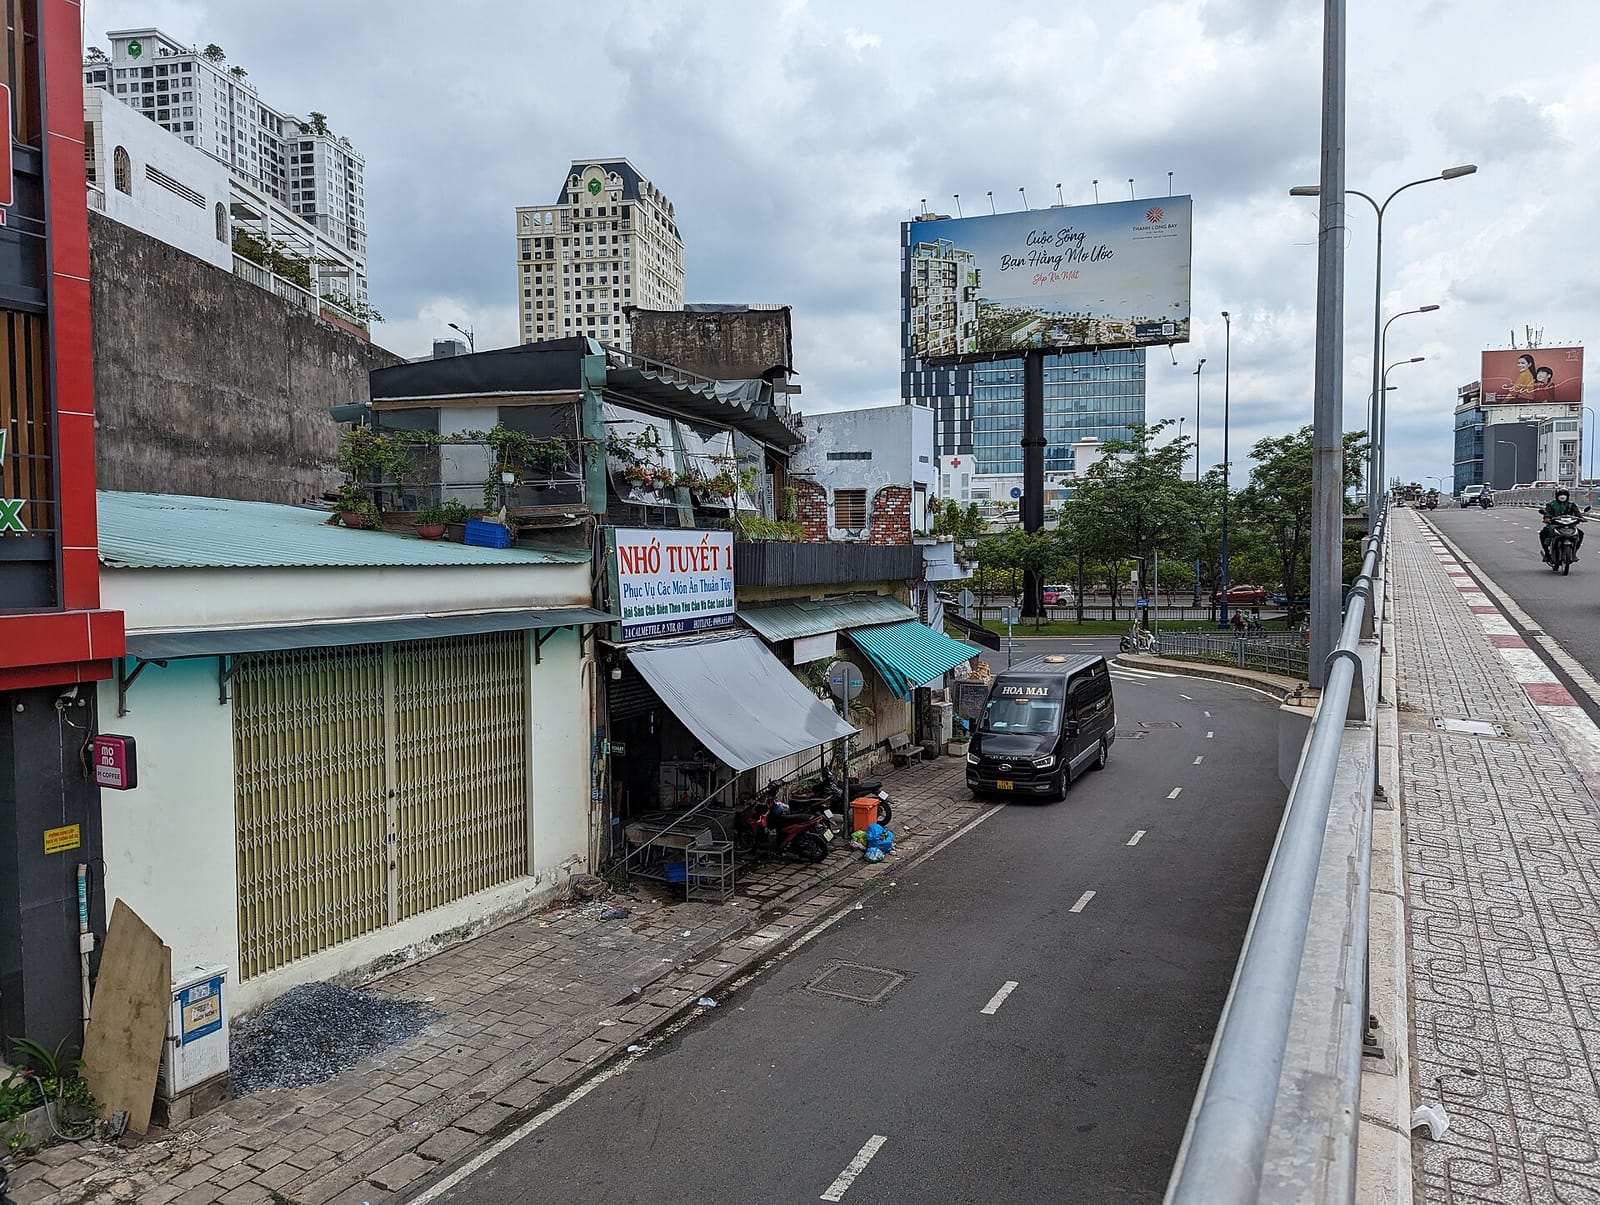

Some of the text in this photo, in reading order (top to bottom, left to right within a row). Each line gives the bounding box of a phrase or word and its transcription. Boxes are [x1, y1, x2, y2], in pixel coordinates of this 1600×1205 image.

[1026, 226, 1087, 248] Cuộc Sống
[1000, 254, 1025, 271] Bạn
[618, 533, 732, 574] NHỚ TUYẾT 1
[623, 582, 642, 600] Phục
[645, 582, 656, 599] Vụ
[657, 580, 670, 596] Các
[672, 580, 688, 595] Món
[1001, 686, 1049, 696] HOA MAI
[102, 771, 121, 780] COFFEE
